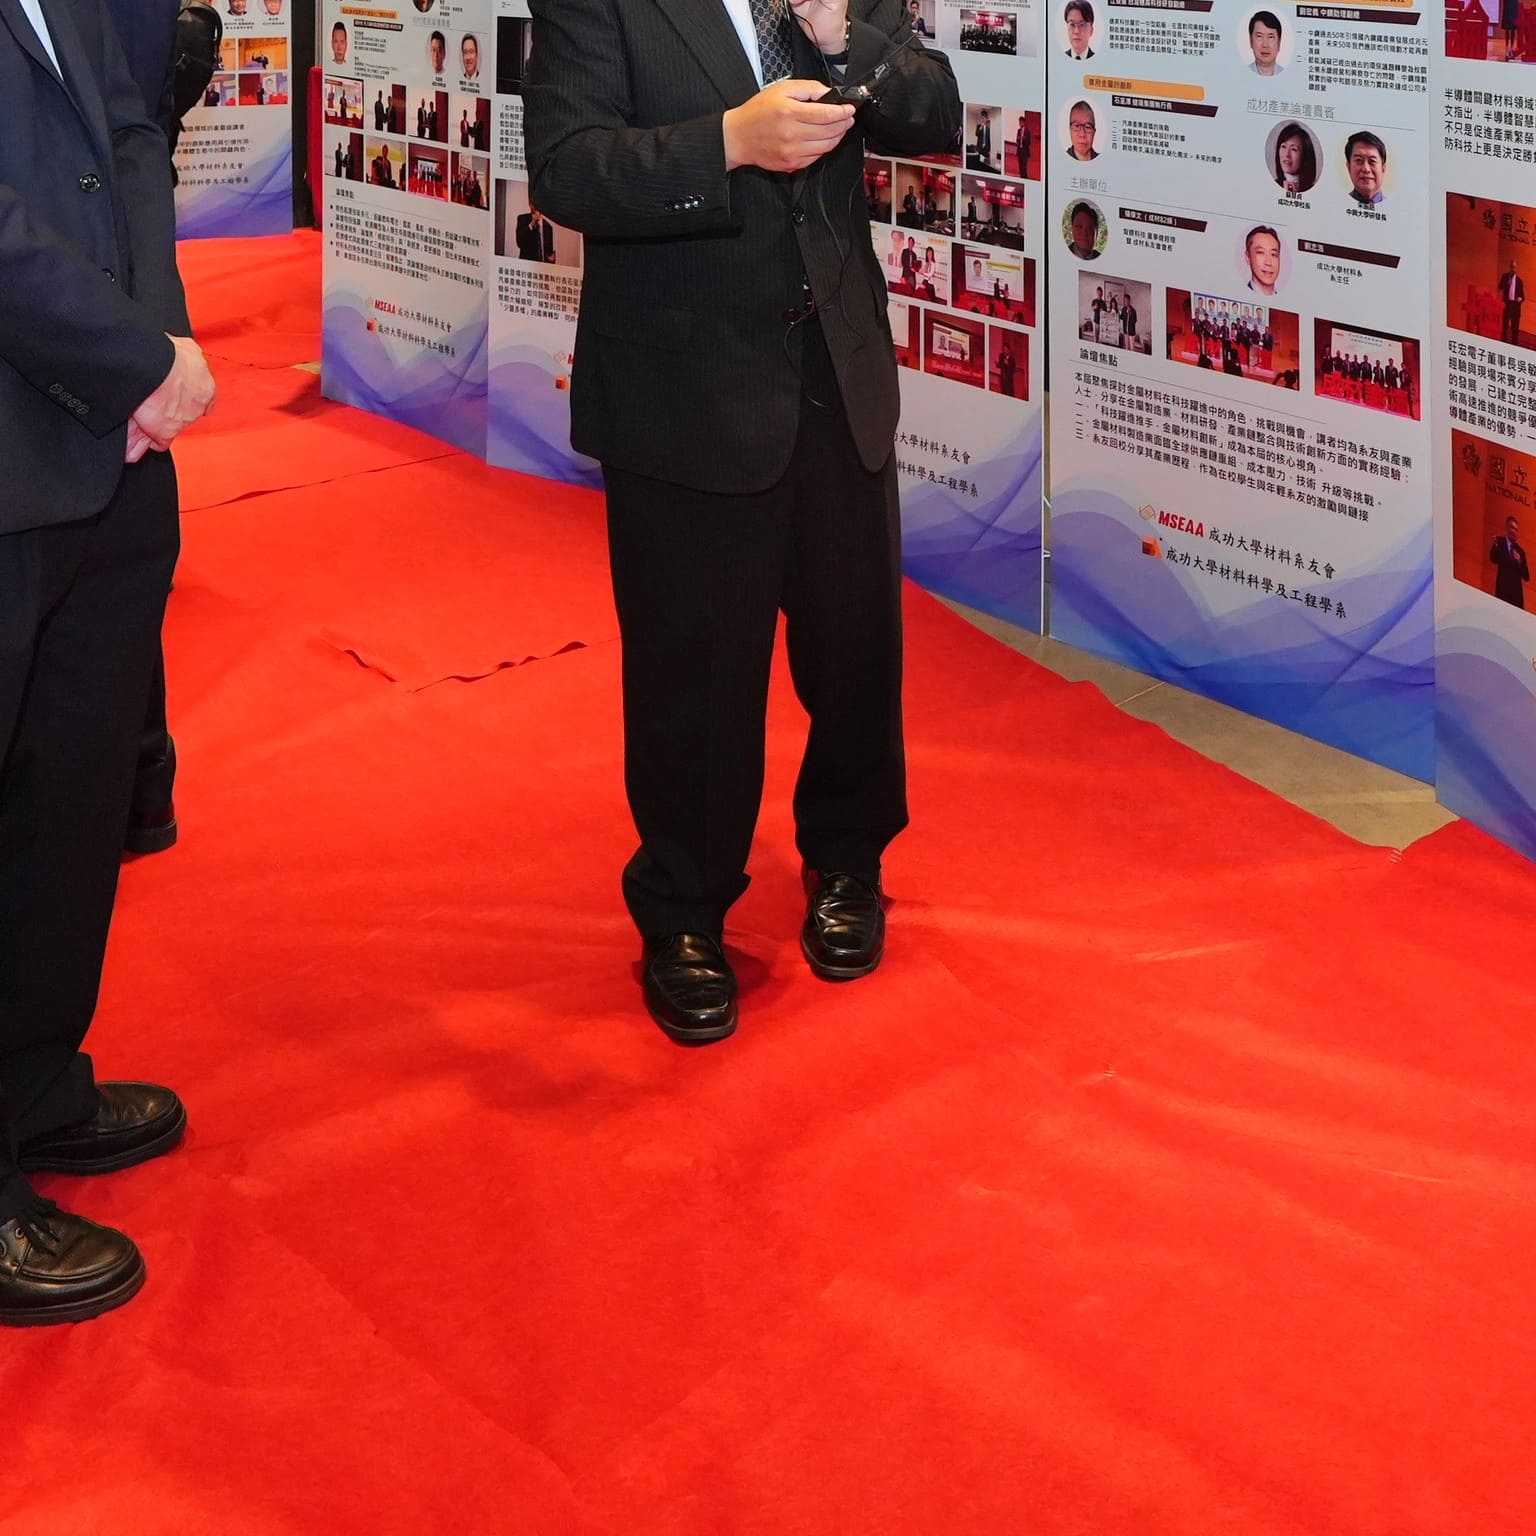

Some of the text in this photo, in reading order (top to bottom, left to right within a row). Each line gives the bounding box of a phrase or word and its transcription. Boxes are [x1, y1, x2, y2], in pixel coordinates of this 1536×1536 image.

[1070, 176, 1108, 193] 主辦單位
[375, 299, 396, 315] MSEAA
[1079, 347, 1118, 368] 論壇焦點
[1159, 510, 1337, 581] MSEAA 成功大學材料系友會
[1165, 546, 1348, 619] 成功大學材料科學及工程學系
